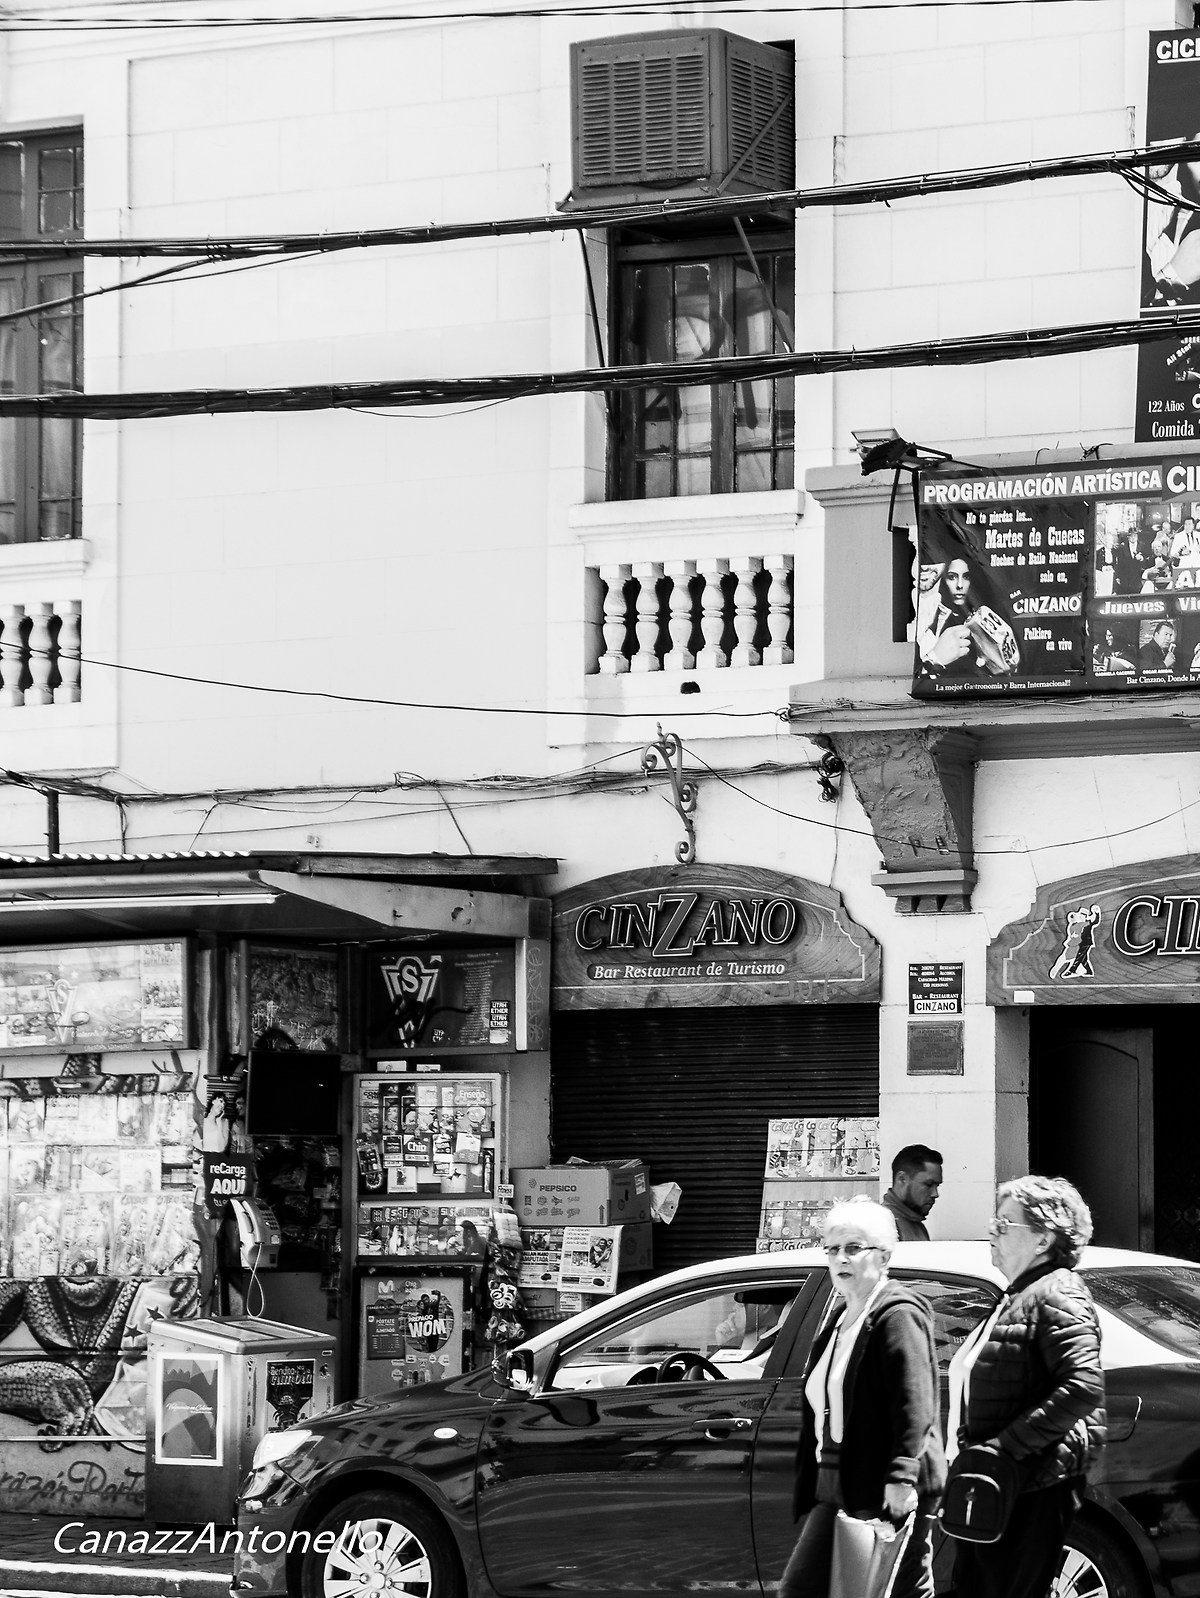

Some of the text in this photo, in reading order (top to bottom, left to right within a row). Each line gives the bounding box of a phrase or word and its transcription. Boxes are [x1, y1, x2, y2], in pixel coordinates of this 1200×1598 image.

[1166, 353, 1178, 366] All
[1148, 400, 1162, 413] 122
[1164, 398, 1185, 412] Años
[1151, 419, 1195, 438] Comida
[923, 472, 1068, 503] PROGRAMACIÓN
[1071, 467, 1162, 494] ARTÍSTICA
[966, 512, 977, 524] No
[979, 512, 987, 523] te
[989, 511, 1013, 525] pierdas
[985, 526, 1085, 550] Martes de Cuecas
[990, 550, 1078, 567] Noches de Baile Nacional
[1040, 571, 1054, 584] solo
[1012, 596, 1081, 615] CINZANO
[1099, 600, 1165, 615] Jueves
[1024, 627, 1052, 641] Folklore
[1046, 638, 1073, 651] en vivo
[1127, 676, 1137, 684] Bar
[1139, 675, 1166, 684] Cinzano,
[1167, 674, 1189, 682] Donde
[1190, 673, 1195, 681] la
[945, 684, 963, 692] mejor
[1009, 681, 1026, 689] Barra
[575, 892, 797, 957] CINZANO
[594, 961, 785, 980] Bar Restaurant de Turismo
[916, 1001, 956, 1011] CINZANO
[210, 1163, 247, 1177] reCarga
[210, 1174, 247, 1195] AQUÍ
[539, 1184, 578, 1193] PEPSICO
[408, 1320, 448, 1338] WOM
